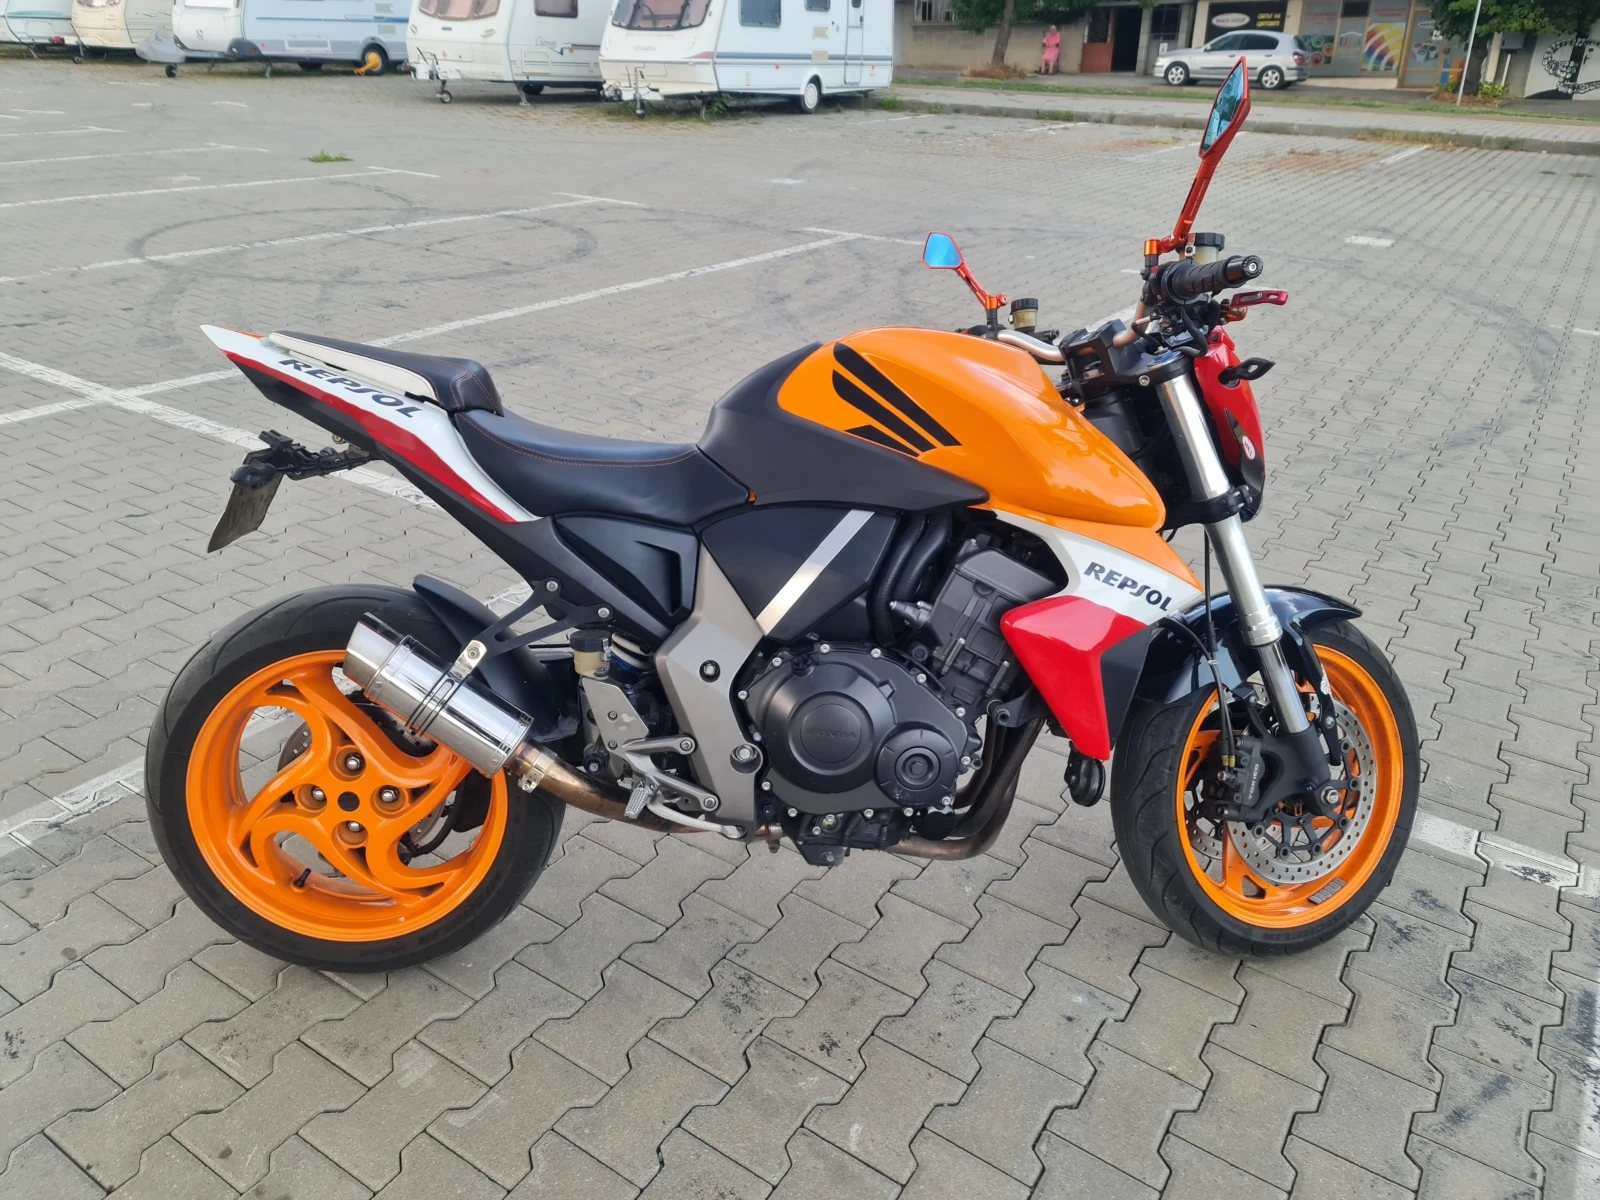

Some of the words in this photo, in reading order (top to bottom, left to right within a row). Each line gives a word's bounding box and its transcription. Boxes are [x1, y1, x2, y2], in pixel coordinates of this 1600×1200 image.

[277, 358, 424, 418] REPSOL
[1084, 561, 1173, 612] REPSOL
[806, 728, 857, 740] HONDA
